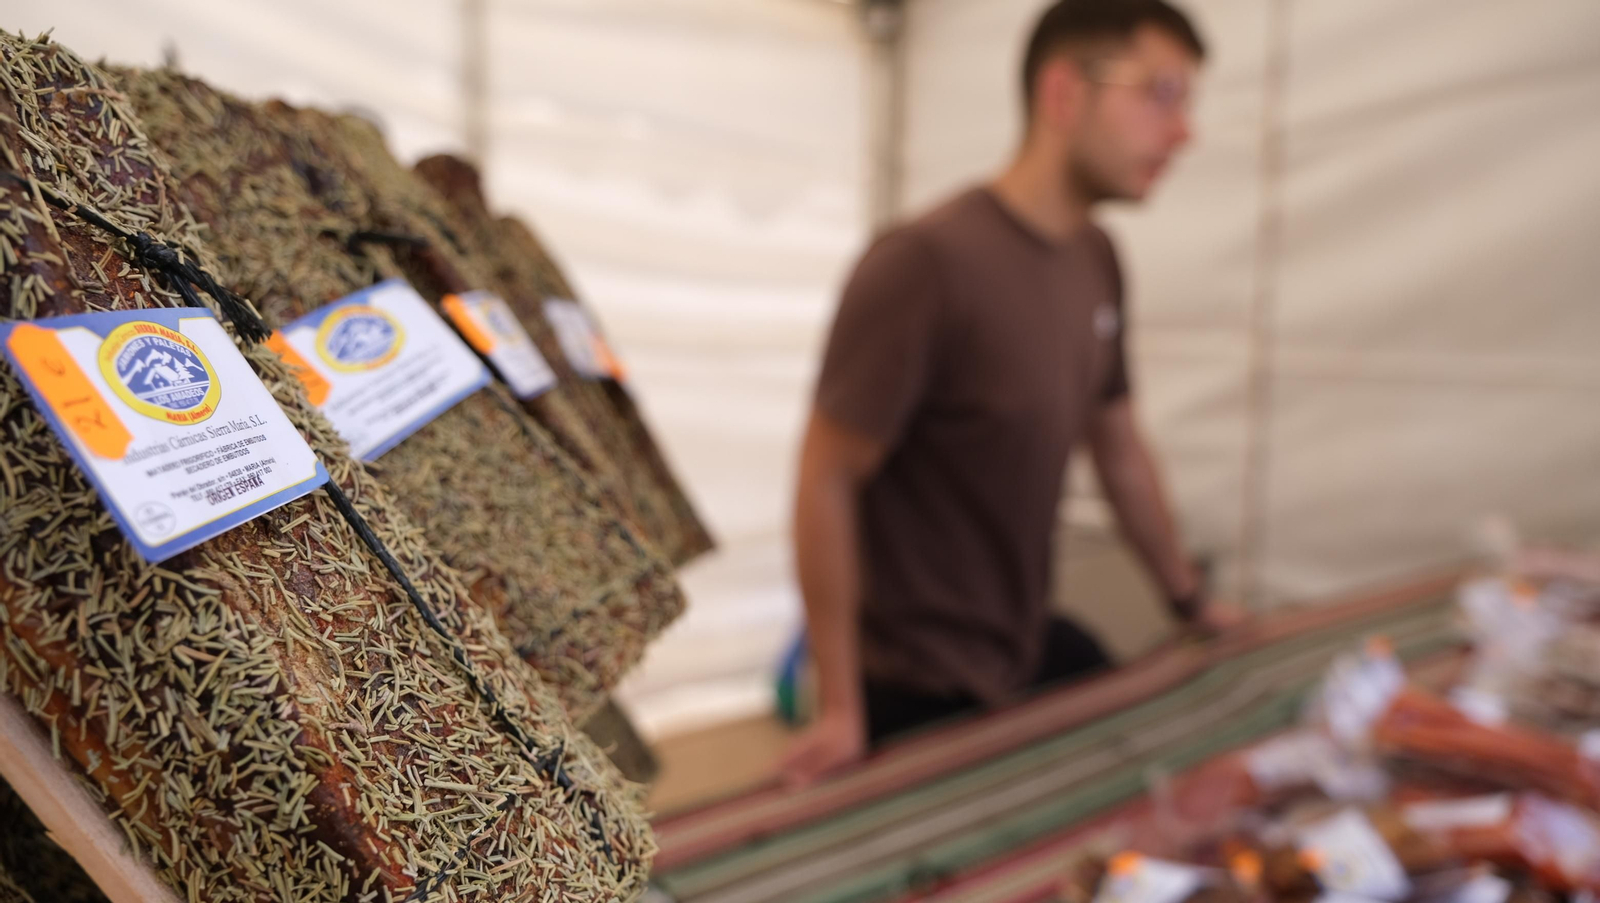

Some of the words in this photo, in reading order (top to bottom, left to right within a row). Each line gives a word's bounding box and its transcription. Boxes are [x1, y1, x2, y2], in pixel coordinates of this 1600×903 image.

[118, 338, 147, 371] JAMONES
[144, 336, 152, 347] Y
[152, 337, 192, 358] PALETAS
[152, 394, 172, 406] LOS
[170, 387, 205, 402] AMADEOS
[169, 431, 208, 450] Cárnicas
[206, 425, 232, 439] Sierra
[237, 440, 246, 448] DE
[243, 434, 267, 445] EMBUTIDOS
[214, 456, 223, 465] DE
[222, 447, 250, 462] EMBUTIDOS
[206, 486, 236, 506] ORIGEN
